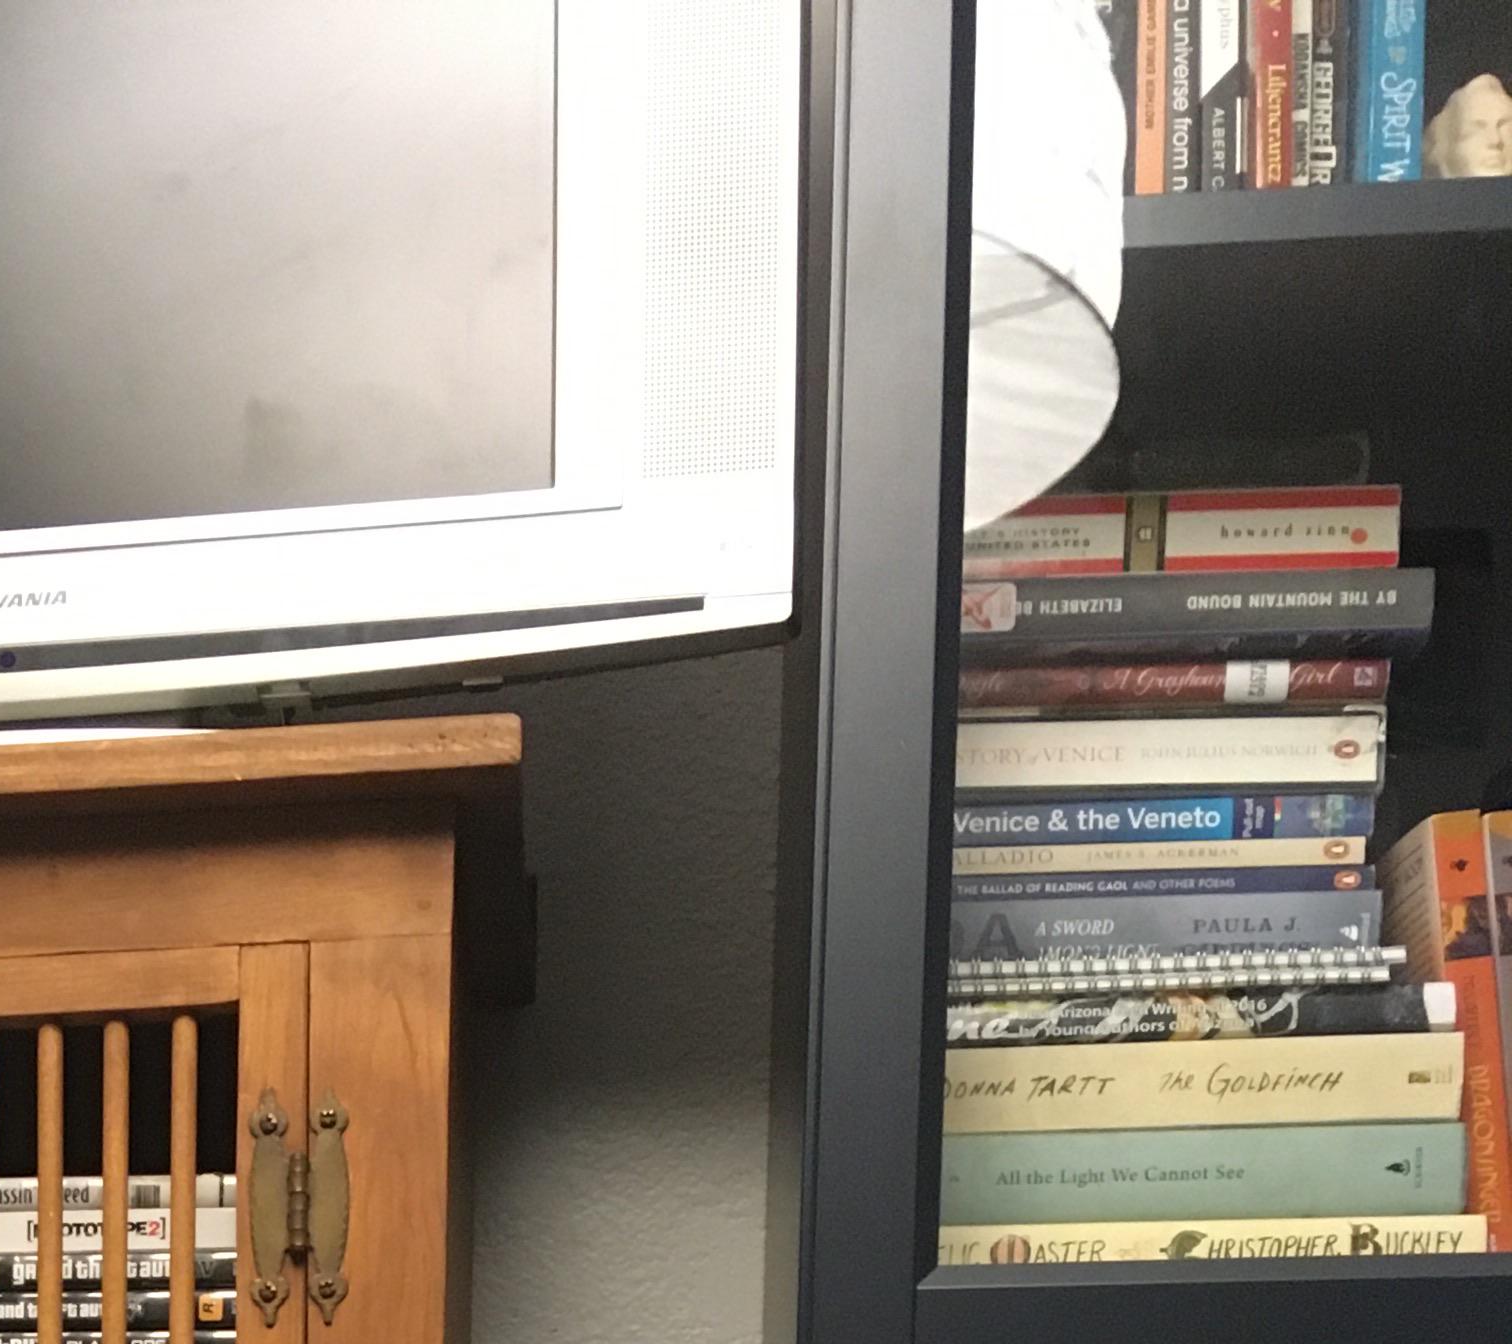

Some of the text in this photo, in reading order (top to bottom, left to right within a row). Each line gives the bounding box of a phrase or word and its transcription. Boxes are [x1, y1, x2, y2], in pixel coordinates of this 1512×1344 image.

[1173, 17, 1193, 112] universe
[1312, 62, 1334, 147] GEORGE
[1380, 71, 1417, 154] SPIRIT
[1173, 117, 1193, 171] from
[1212, 107, 1226, 170] ALBERT
[1031, 538, 1091, 549] STATES
[1221, 523, 1293, 539] howard
[1039, 598, 1123, 615] ELIZABETH
[1186, 590, 1397, 611] BY THE MOUNTAIN BOUND
[1137, 665, 1226, 697] Greyhoun
[1042, 746, 1125, 763] VENICE
[953, 806, 1221, 834] Venice & the Veneto
[981, 883, 1023, 895] BALLAD
[1026, 882, 1041, 894] OF
[1045, 881, 1094, 893] READING
[1097, 880, 1128, 892] GAOL
[1159, 878, 1195, 890] OTHER
[1198, 877, 1236, 889] POEMS
[1035, 919, 1114, 937] A SWORD
[1193, 916, 1273, 934] PAULA
[1027, 1074, 1116, 1103] TARTT
[1158, 1070, 1195, 1092] The
[1207, 1062, 1344, 1103] GOLDFINCH
[996, 1164, 1245, 1189] All the Light We Cannot See
[1349, 1222, 1463, 1256] BUCKLEY
